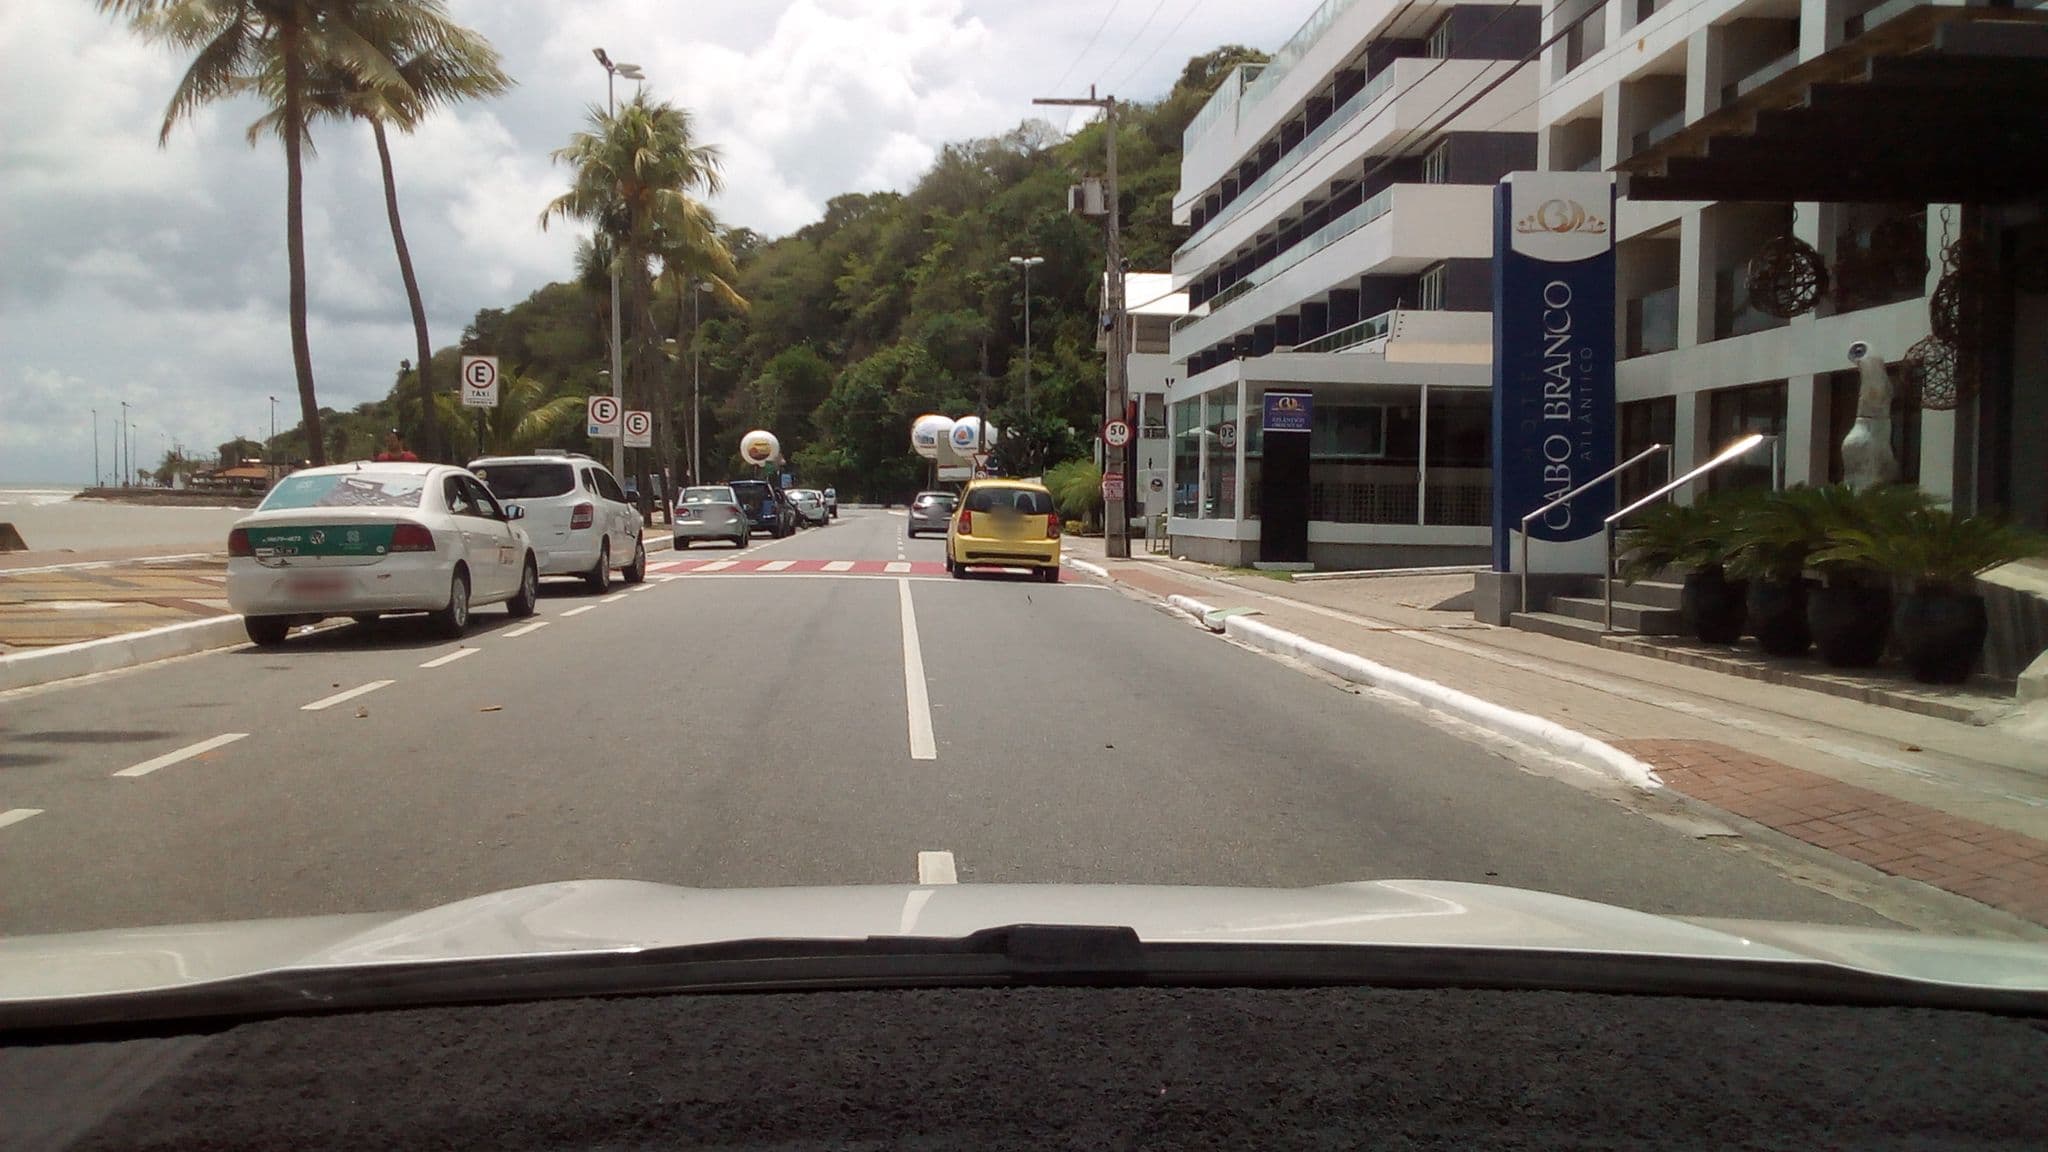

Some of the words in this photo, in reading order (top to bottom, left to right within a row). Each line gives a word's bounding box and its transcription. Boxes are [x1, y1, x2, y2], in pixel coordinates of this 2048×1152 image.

[1542, 281, 1573, 421] BRANCO
[475, 366, 486, 383] E
[600, 403, 610, 418] E
[1577, 346, 1594, 461] ATLÂNTICO
[633, 417, 642, 430] E
[1110, 424, 1126, 436] 50
[1542, 435, 1573, 531] CABO
